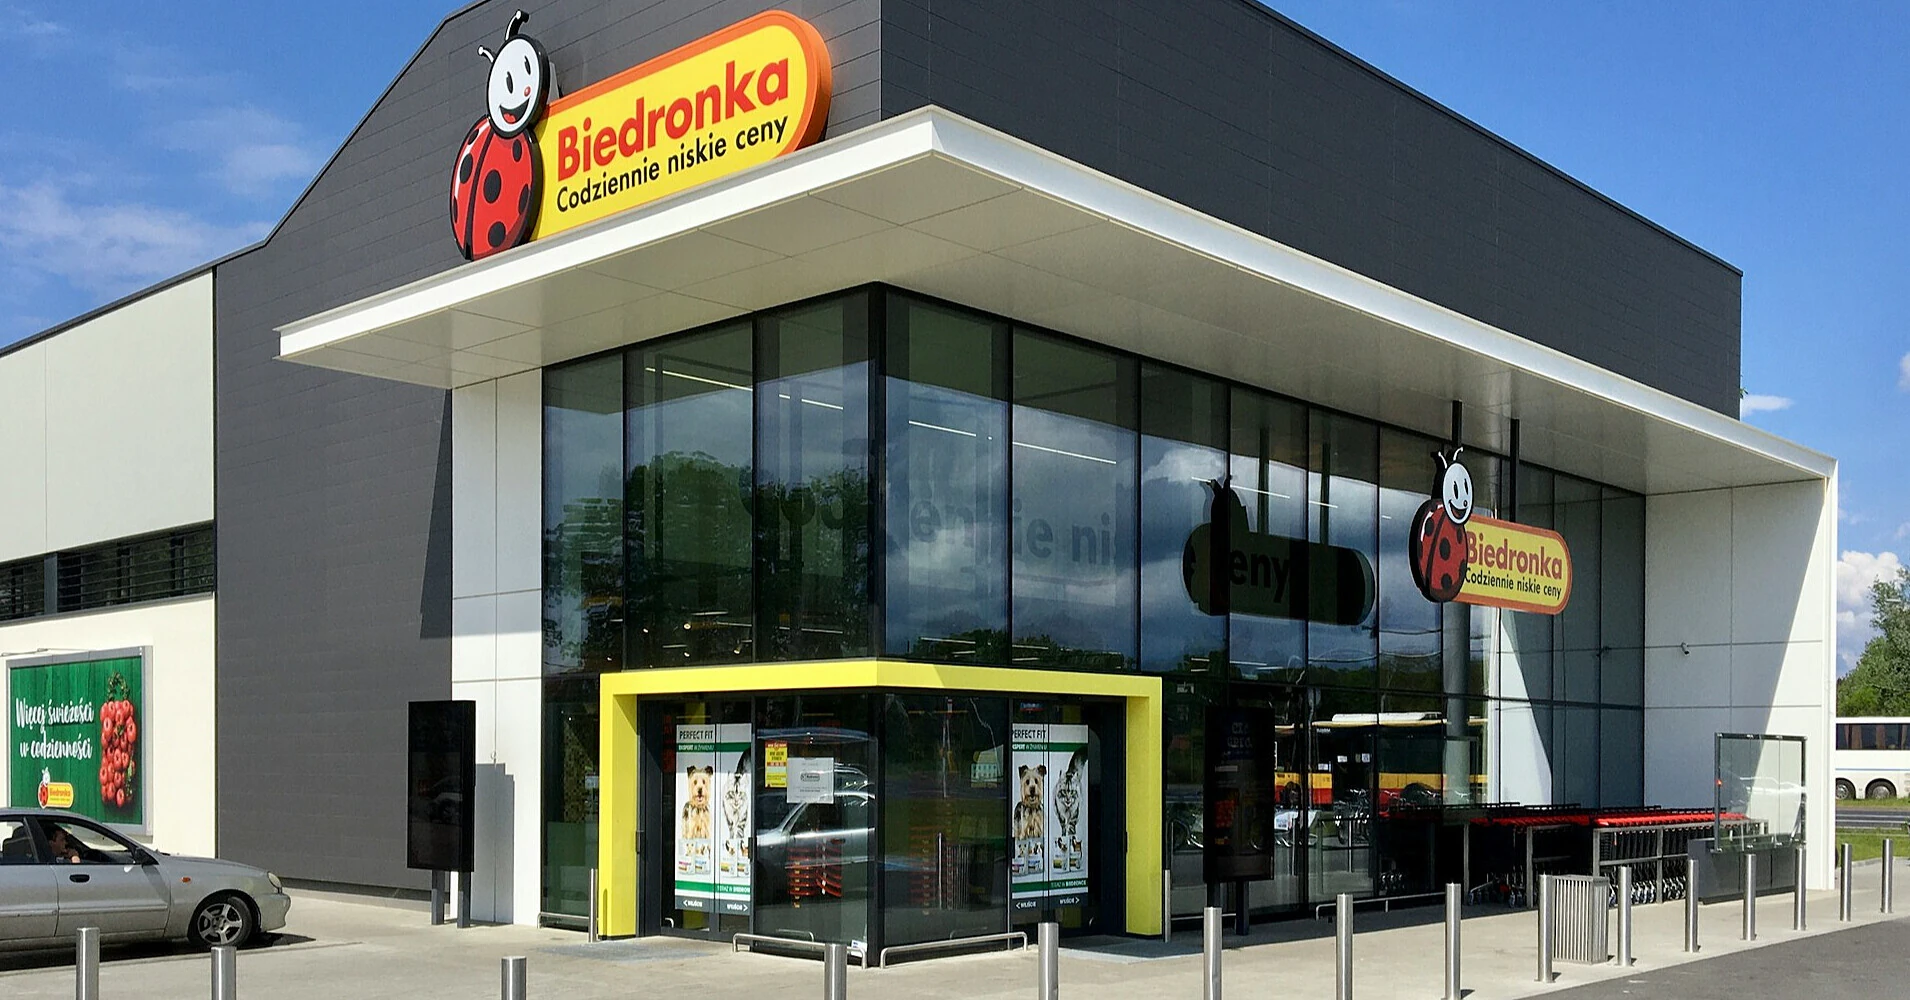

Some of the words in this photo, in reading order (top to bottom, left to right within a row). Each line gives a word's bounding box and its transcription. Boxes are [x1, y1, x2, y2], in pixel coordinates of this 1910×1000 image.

[557, 57, 789, 181] Biedronka
[556, 156, 660, 213] Codziennie
[667, 133, 727, 175] niskie
[735, 116, 789, 150] ceny
[1466, 531, 1562, 580] Biedronka
[1229, 549, 1290, 603] eny
[1465, 567, 1514, 590] Codziennie
[1516, 576, 1541, 594] niskie
[1543, 585, 1562, 600] ceny
[15, 697, 46, 733] Więcej
[47, 697, 95, 725] świeżości
[31, 731, 93, 760] codzienności
[679, 730, 703, 740] PERFECT
[704, 730, 714, 740] FIT
[1036, 729, 1046, 739] FIT
